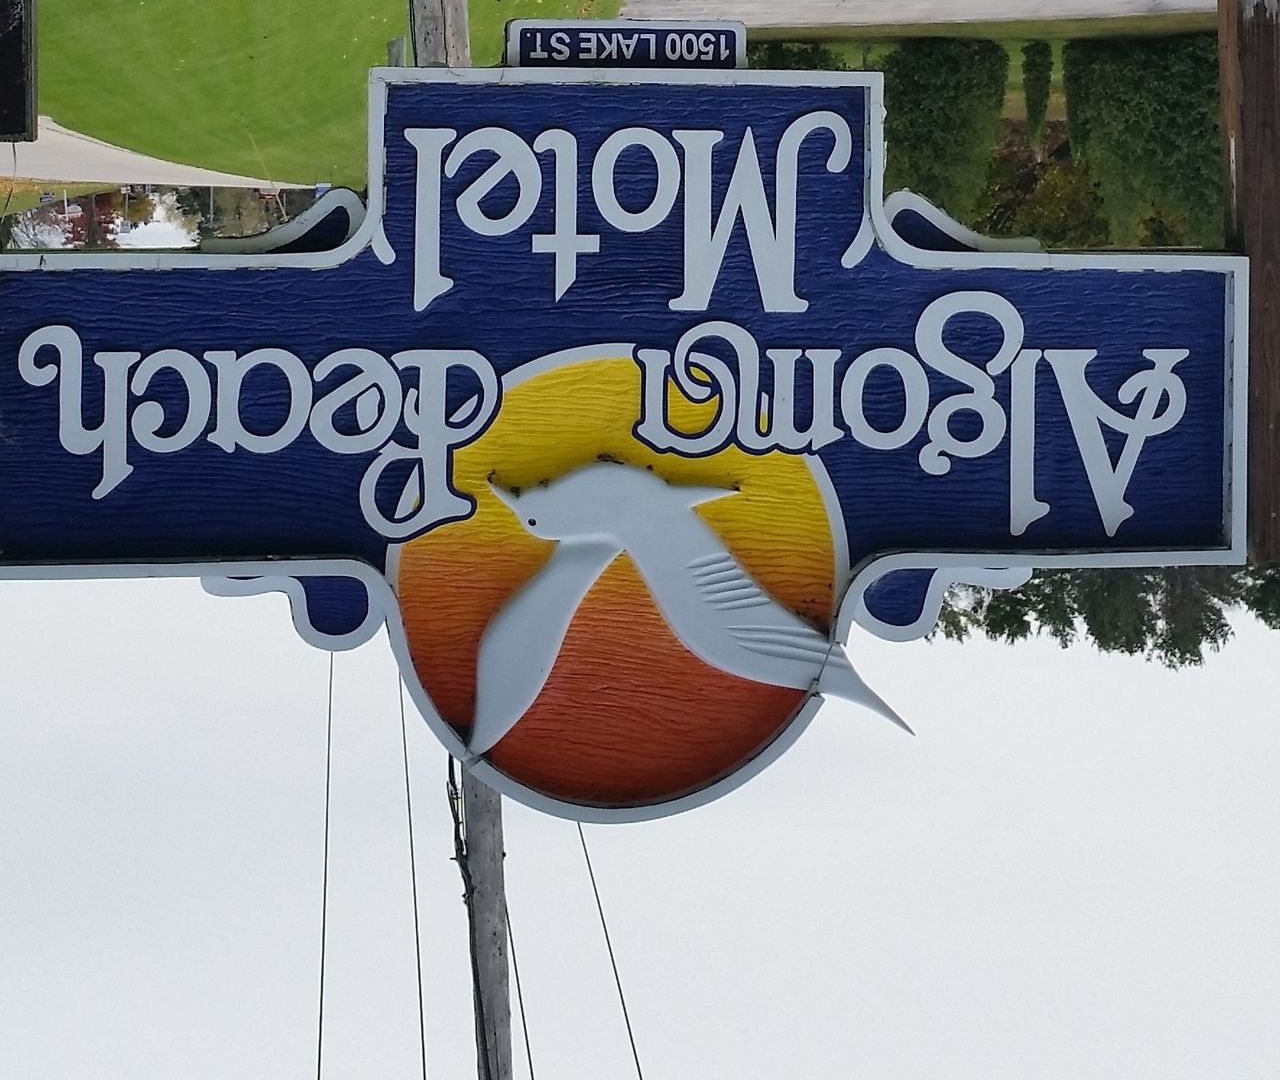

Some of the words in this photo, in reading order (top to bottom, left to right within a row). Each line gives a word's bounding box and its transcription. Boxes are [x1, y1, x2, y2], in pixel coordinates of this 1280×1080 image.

[524, 31, 571, 60] ST.
[578, 31, 656, 60] LAKE
[664, 31, 731, 60] 1500
[405, 110, 854, 313] Motel
[18, 325, 499, 541] Beach
[630, 291, 1188, 537] Algoma
